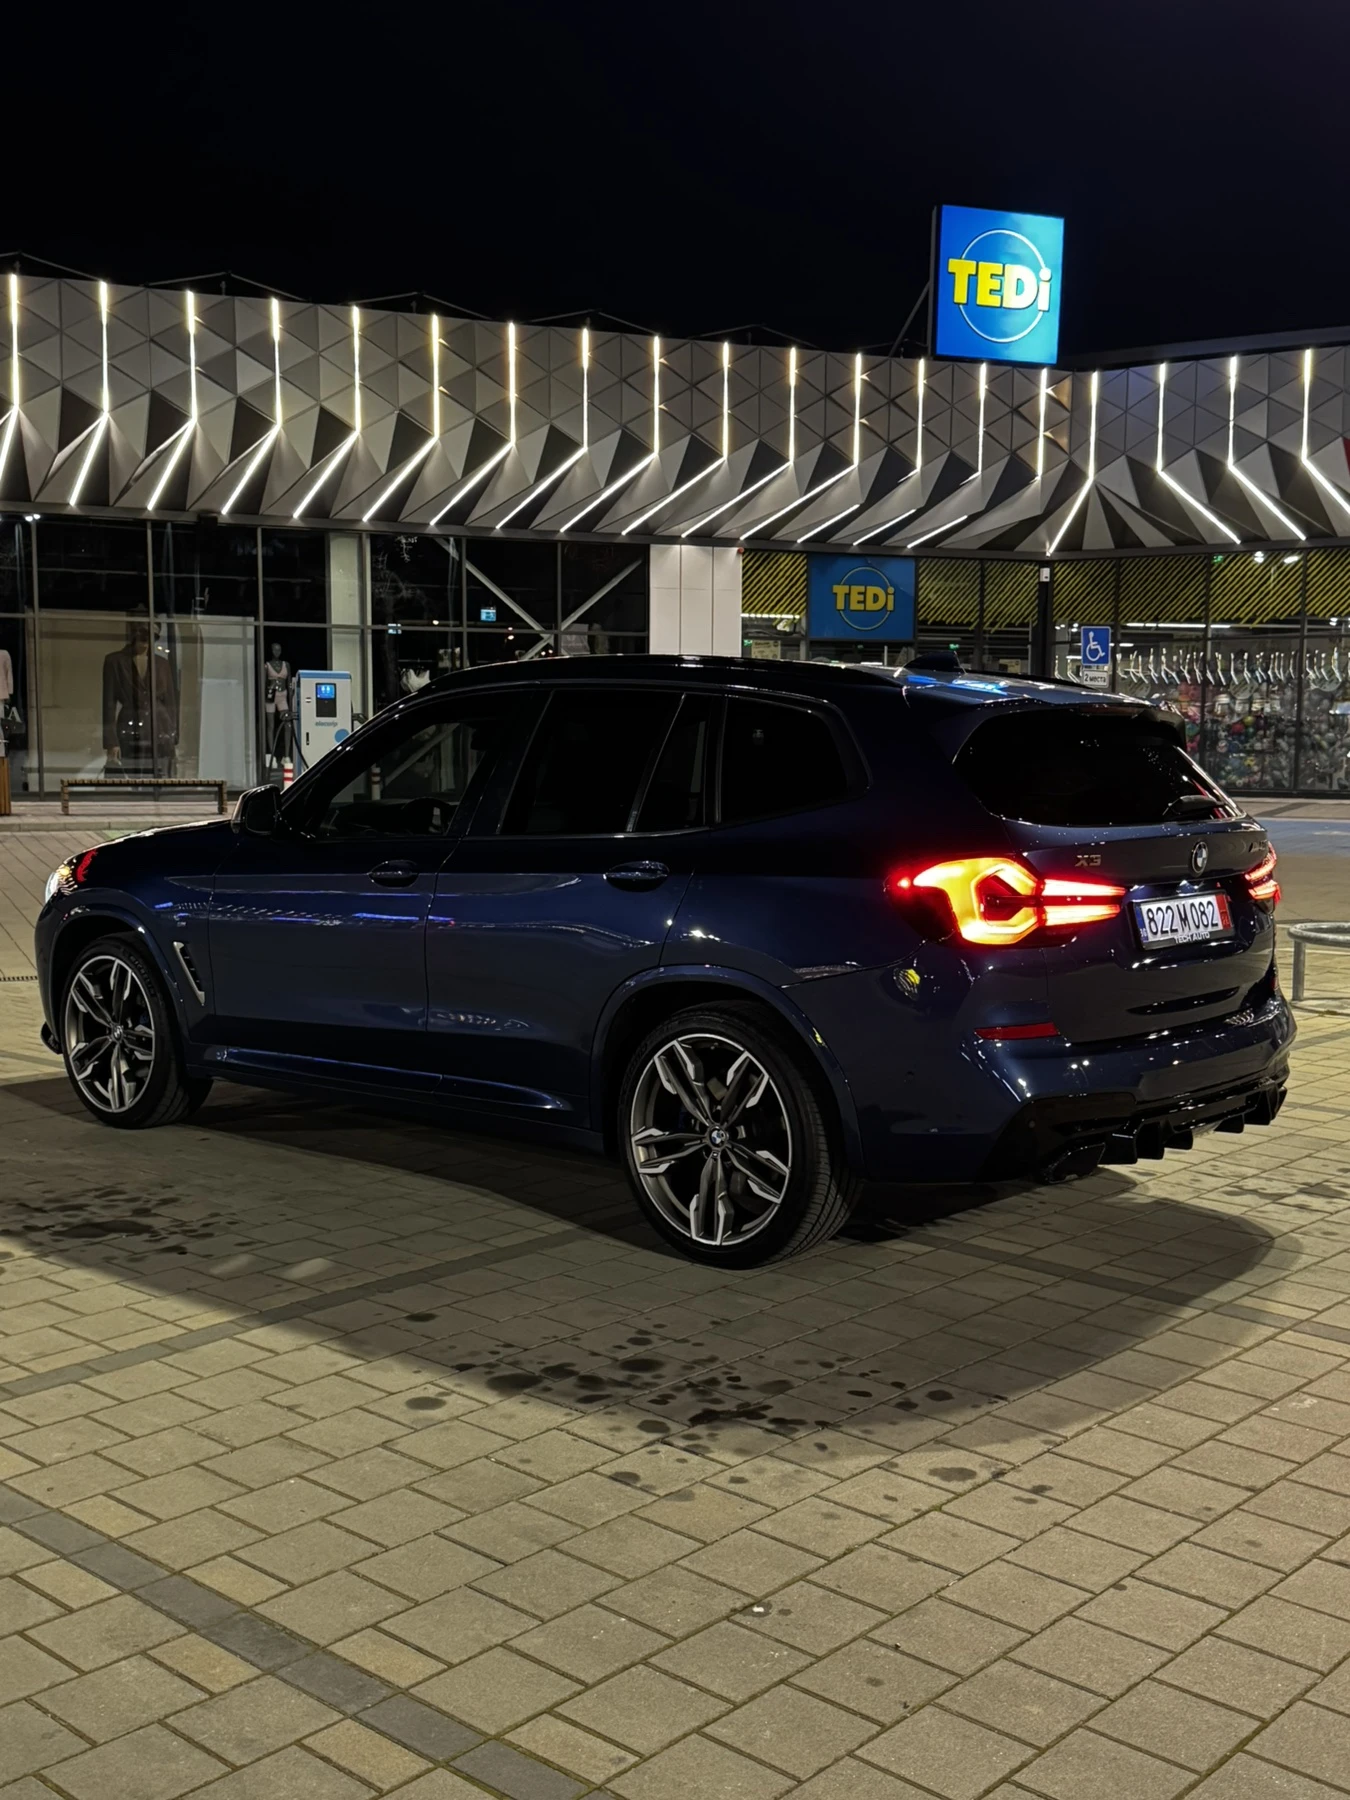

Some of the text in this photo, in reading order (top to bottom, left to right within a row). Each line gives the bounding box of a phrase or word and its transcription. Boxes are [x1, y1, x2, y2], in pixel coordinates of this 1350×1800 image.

[948, 258, 1053, 312] TEDi
[832, 585, 894, 611] TEDi
[1084, 673, 1089, 682] 2
[1074, 854, 1101, 867] X3
[1146, 905, 1178, 935] 822
[1176, 903, 1191, 932] M
[1190, 900, 1219, 929] 082
[1174, 931, 1211, 944] TECH AUTO
